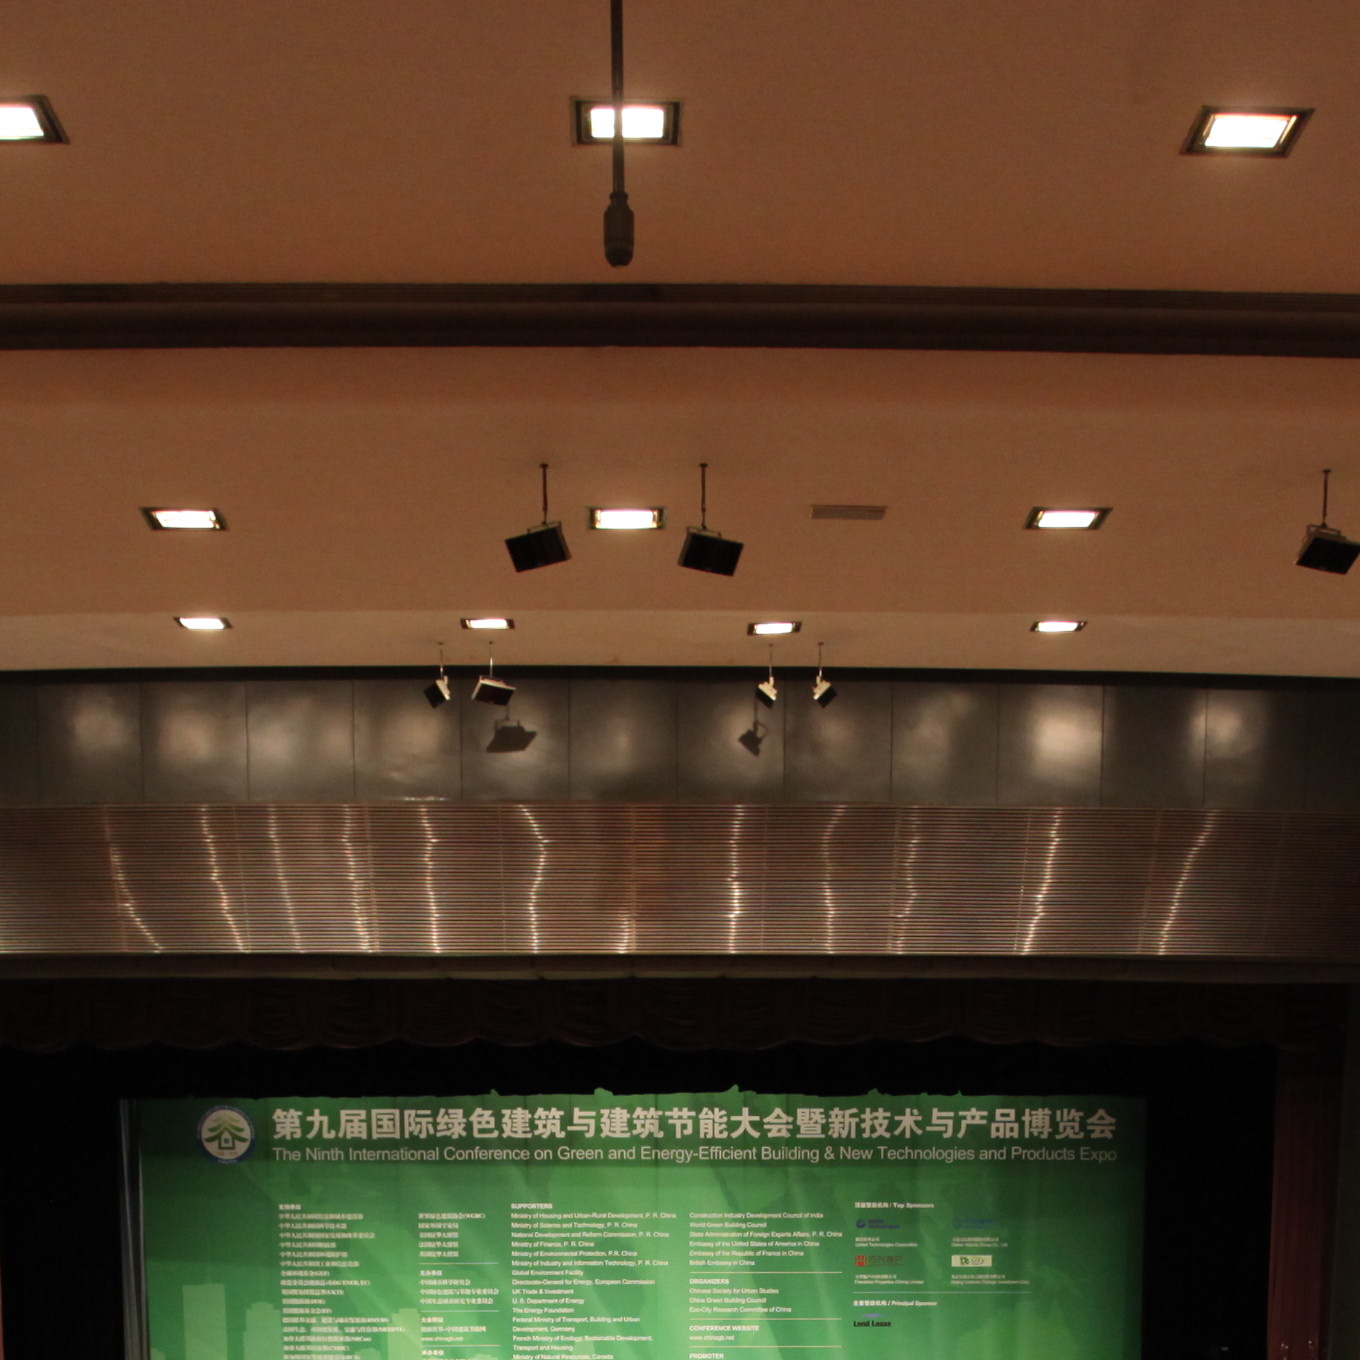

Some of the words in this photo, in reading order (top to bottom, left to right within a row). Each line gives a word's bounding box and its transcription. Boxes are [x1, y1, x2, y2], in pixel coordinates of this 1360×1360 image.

[272, 1108, 1116, 1140] 第九届国际绿色建筑与建筑节能大会暨新技术与产品博览会
[274, 1148, 301, 1160] The
[306, 1148, 344, 1160] Ninth
[350, 1147, 439, 1160] International
[444, 1146, 530, 1160] Conference
[534, 1150, 552, 1160] on
[558, 1146, 603, 1159] Green
[608, 1147, 635, 1159] and
[641, 1146, 757, 1163] Energy-Efficient
[762, 1146, 819, 1163] Building
[824, 1146, 835, 1159] &
[840, 1146, 873, 1159] New
[877, 1146, 975, 1163] Technologies
[979, 1147, 1006, 1160] and
[1012, 1147, 1075, 1160] Products
[1081, 1148, 1116, 1163] Expo
